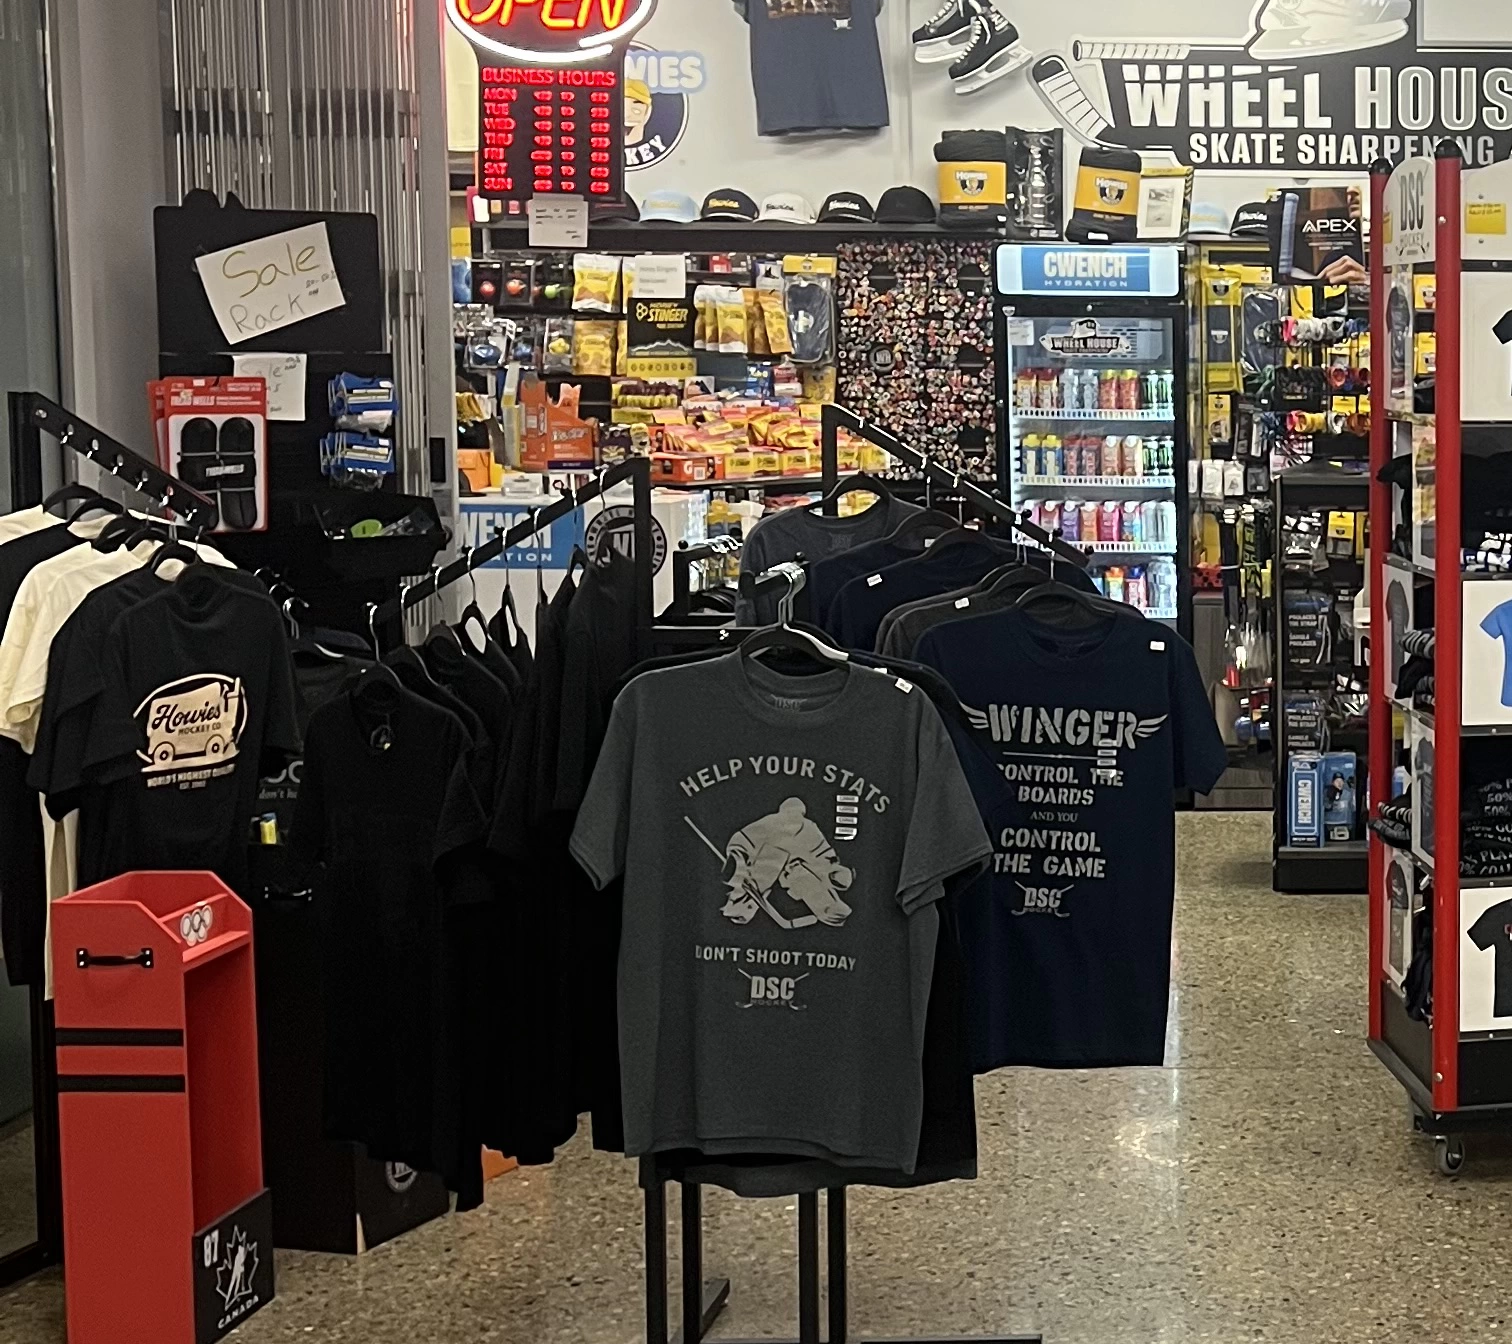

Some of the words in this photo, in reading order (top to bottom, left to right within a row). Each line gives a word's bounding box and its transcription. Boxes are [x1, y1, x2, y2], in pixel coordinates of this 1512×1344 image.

[482, 67, 554, 84] BUSINESS
[557, 70, 616, 86] HOURS
[483, 87, 517, 101] MON
[1122, 64, 1332, 129] WHEEL
[483, 102, 510, 115] TUE
[483, 117, 516, 130] WED
[483, 132, 514, 147] THU
[626, 134, 667, 166] KEY
[1188, 132, 1285, 165] SKATE
[1297, 134, 1494, 167] SHARPENNG
[483, 161, 508, 175] SAT
[483, 177, 513, 191] SUN
[1400, 170, 1424, 232] DSC
[1302, 218, 1357, 233] APEX
[222, 242, 320, 298] Sale
[1043, 251, 1127, 279] CWENCH
[1043, 280, 1128, 288] HYDRATION
[229, 294, 305, 334] Rack
[647, 308, 688, 322] STINGER
[1053, 338, 1085, 348] WHEEL
[1087, 338, 1118, 348] HOUSE
[683, 461, 693, 475] G
[151, 701, 222, 733] Howies
[987, 703, 1137, 749] WINGER
[178, 725, 210, 736] HOCKEY
[678, 759, 744, 798] HELP
[749, 755, 816, 778] YOUR
[822, 764, 892, 815] STATS
[1017, 785, 1094, 805] BOARDS
[1030, 810, 1054, 822] AND
[1057, 812, 1078, 823] YOU
[1000, 828, 1101, 853] CONTROL
[994, 853, 1032, 874] THE
[1043, 855, 1106, 878] GAME
[1024, 887, 1062, 908] DSC
[695, 944, 741, 964] DON'T
[745, 948, 803, 967] SHOOT
[804, 951, 857, 972] TODAY
[750, 975, 796, 1001] DSC
[203, 1228, 220, 1269] 87
[217, 1293, 260, 1330] CANADA
